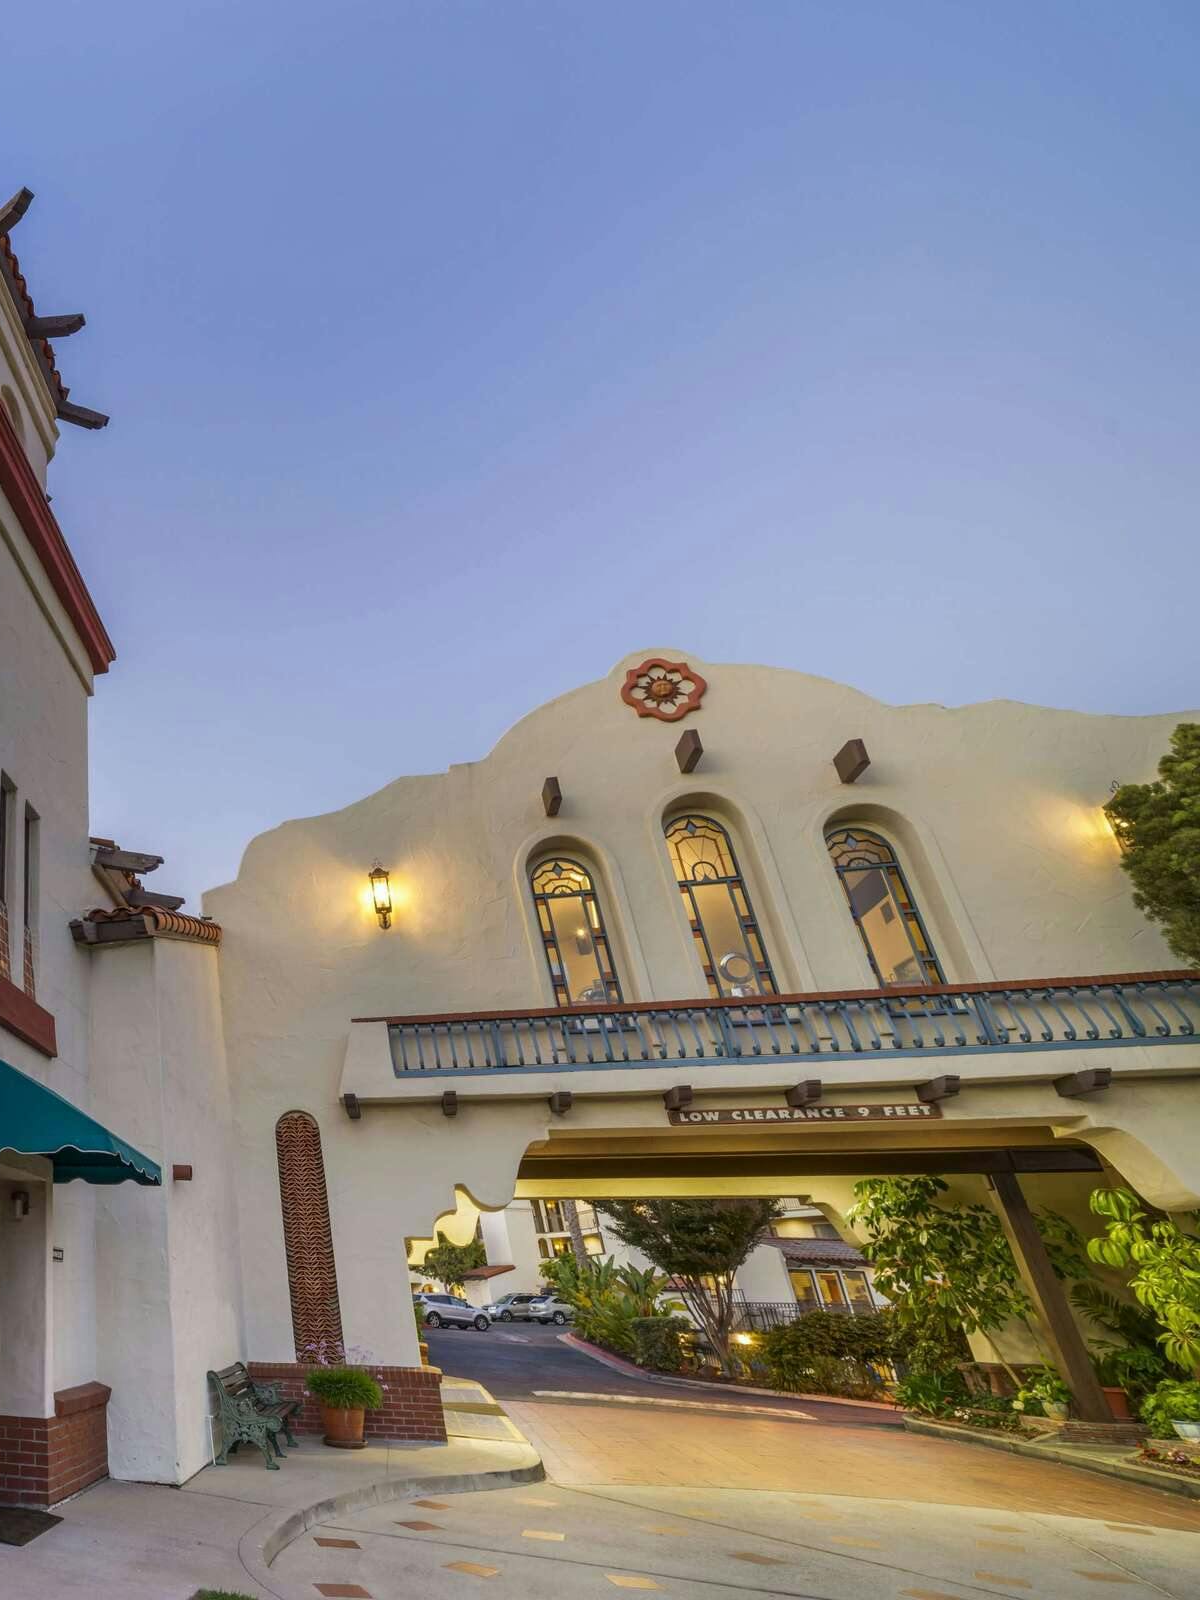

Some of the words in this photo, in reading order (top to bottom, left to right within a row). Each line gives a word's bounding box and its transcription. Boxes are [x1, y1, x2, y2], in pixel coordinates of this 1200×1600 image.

[679, 1111, 719, 1122] LOW
[731, 1107, 845, 1121] CLEARANCE
[857, 1107, 870, 1117] 9
[882, 1105, 931, 1117] FEET
